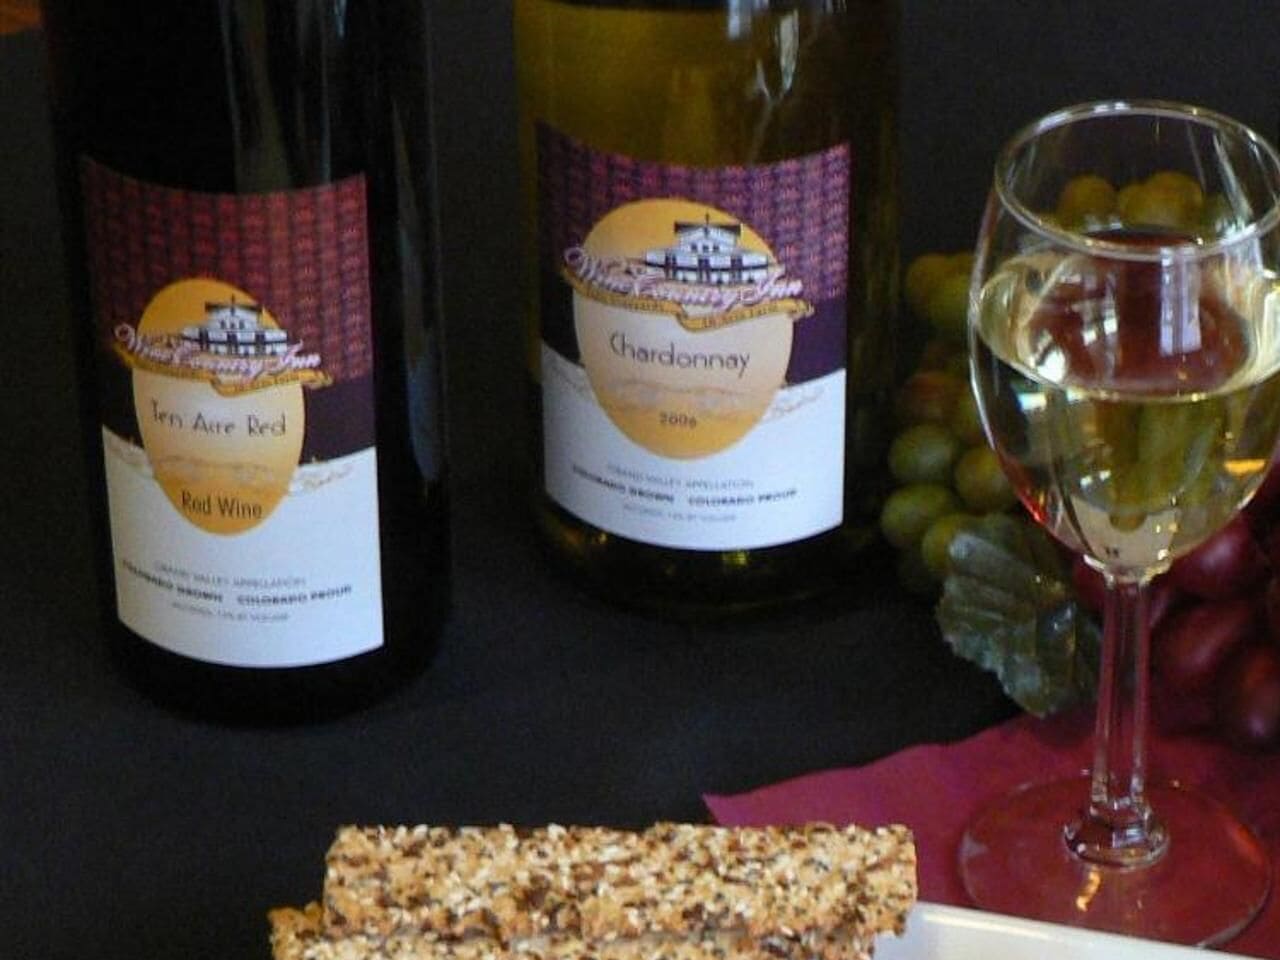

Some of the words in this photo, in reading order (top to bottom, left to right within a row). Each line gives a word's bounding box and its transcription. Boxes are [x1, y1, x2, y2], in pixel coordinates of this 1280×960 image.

[745, 266, 803, 300] Inn
[276, 339, 321, 369] Inn
[609, 331, 750, 378] Chardonnay
[152, 399, 184, 429] Ten
[248, 413, 286, 438] Red
[181, 490, 211, 515] Red
[217, 496, 262, 519] Wine
[688, 494, 755, 508] COLORADO
[237, 592, 307, 606] COLORADO
